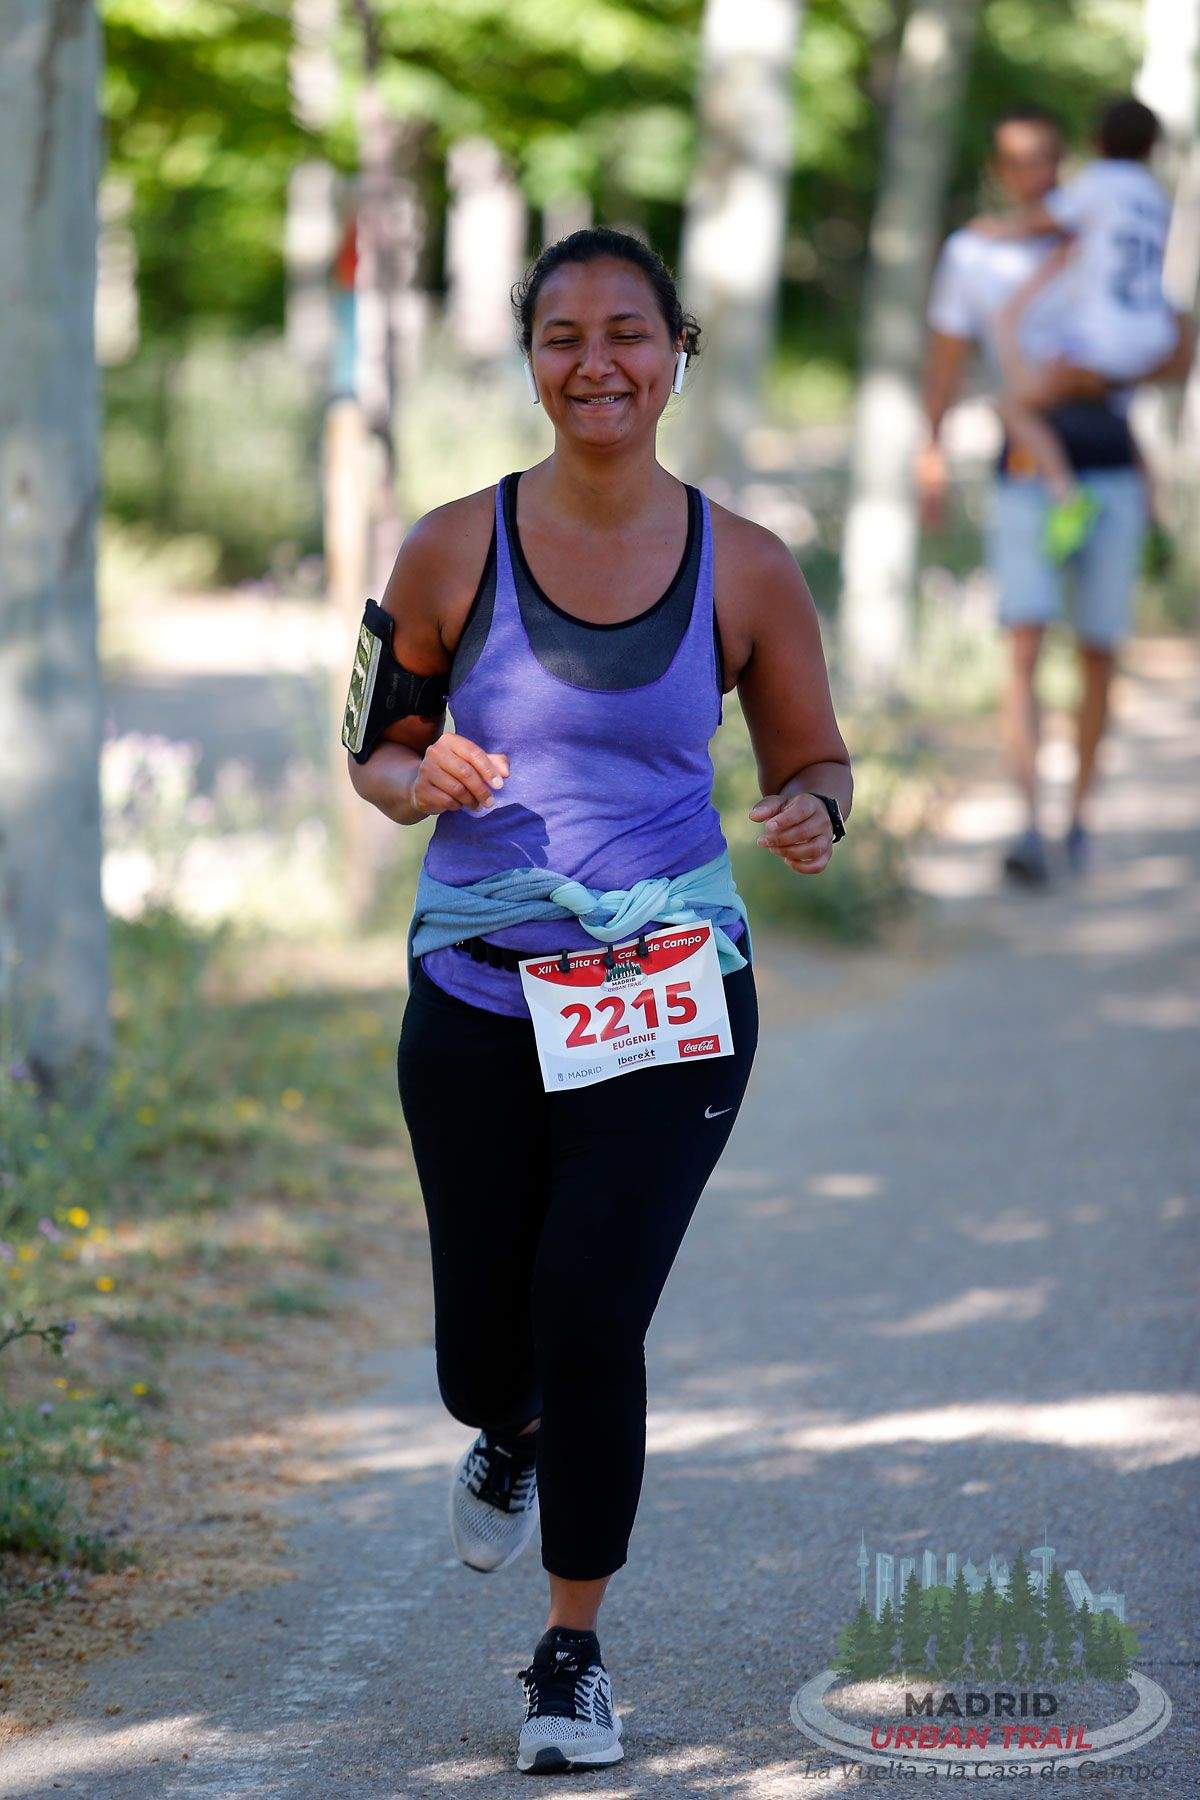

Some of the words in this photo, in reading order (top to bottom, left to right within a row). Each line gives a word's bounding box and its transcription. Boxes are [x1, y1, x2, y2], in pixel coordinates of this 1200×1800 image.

[538, 965, 552, 975] XII
[618, 948, 638, 959] Cas
[648, 943, 660, 952] de
[662, 936, 702, 949] Campo
[612, 977, 636, 987] MADRID
[560, 981, 698, 1048] 2215
[612, 1032, 657, 1050] EUGENIE
[568, 1066, 602, 1079] MADRID
